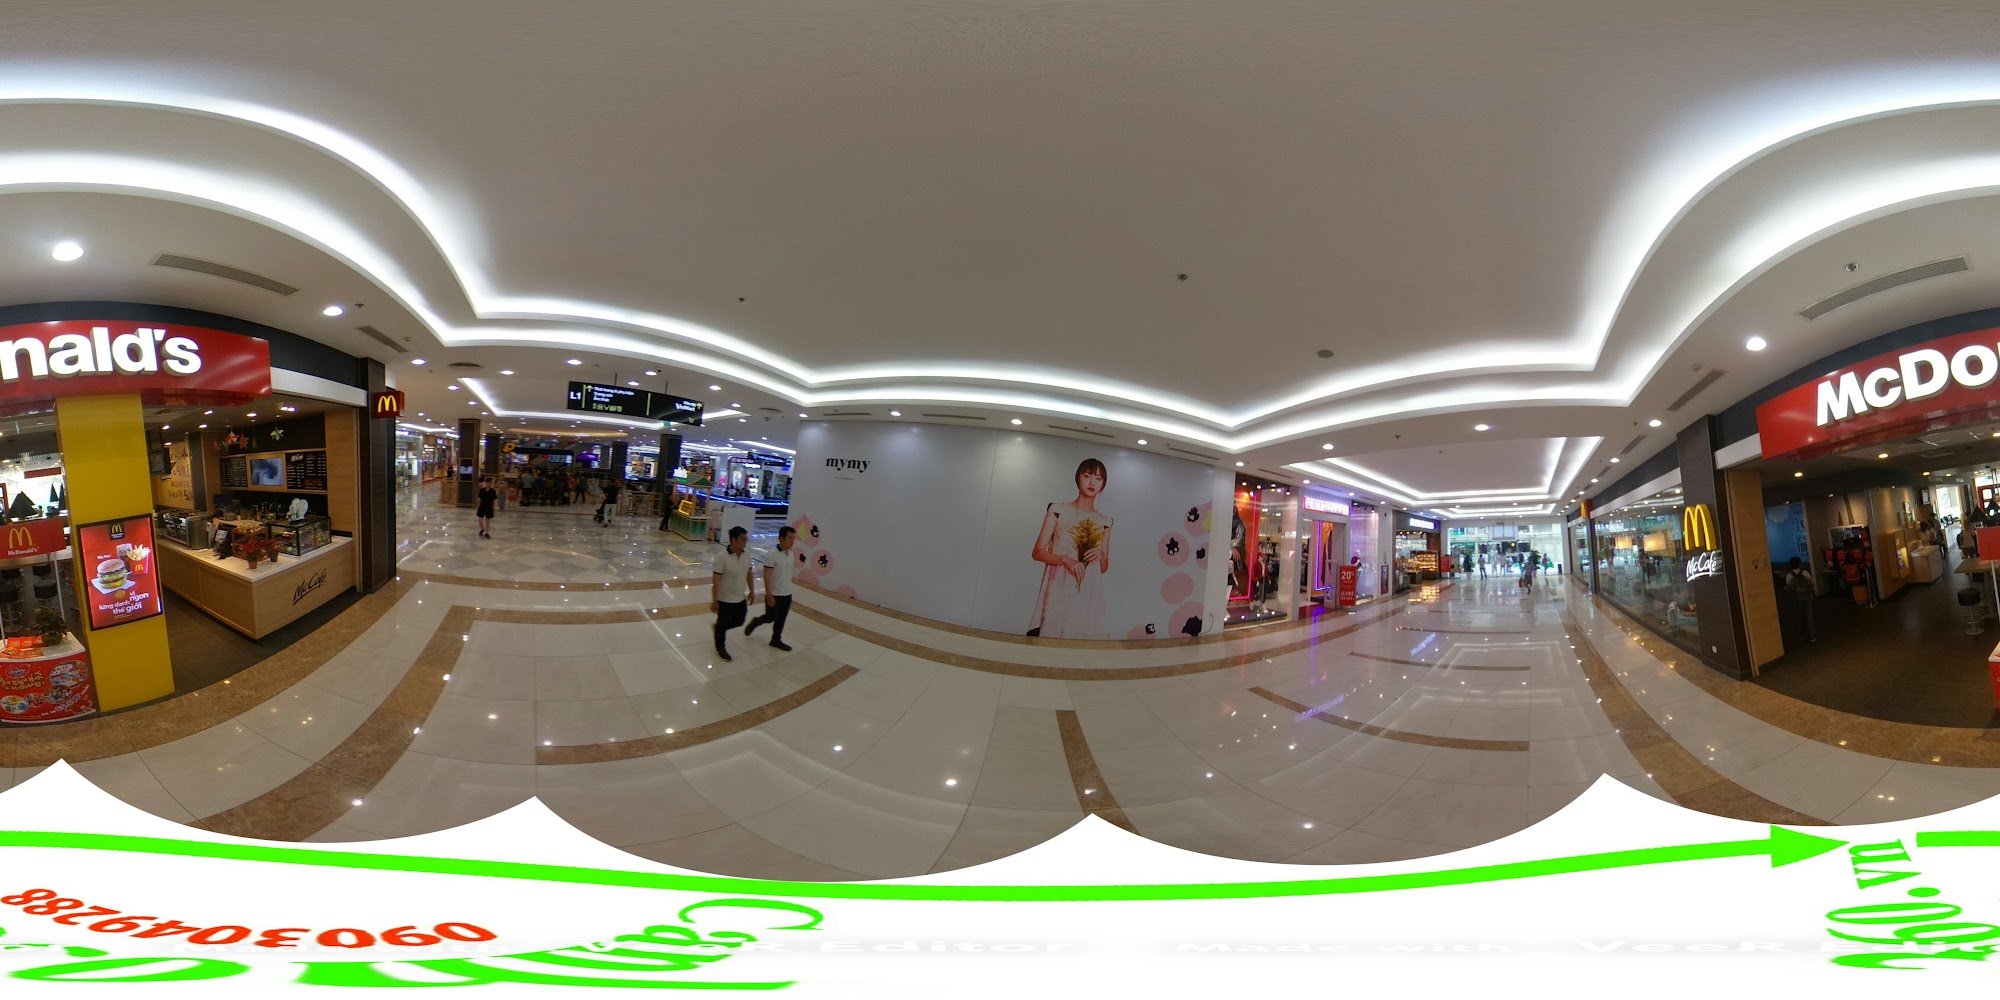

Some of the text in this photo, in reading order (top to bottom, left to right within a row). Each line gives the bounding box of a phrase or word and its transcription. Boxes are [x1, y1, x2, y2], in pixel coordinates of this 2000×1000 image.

[0, 325, 202, 380] nald's
[569, 391, 581, 400] L1
[1816, 345, 1999, 427] McDo
[825, 457, 871, 474] mymy
[7, 546, 39, 556] McDonald's
[1686, 550, 1717, 582] McCafé
[293, 568, 327, 605] McCafé
